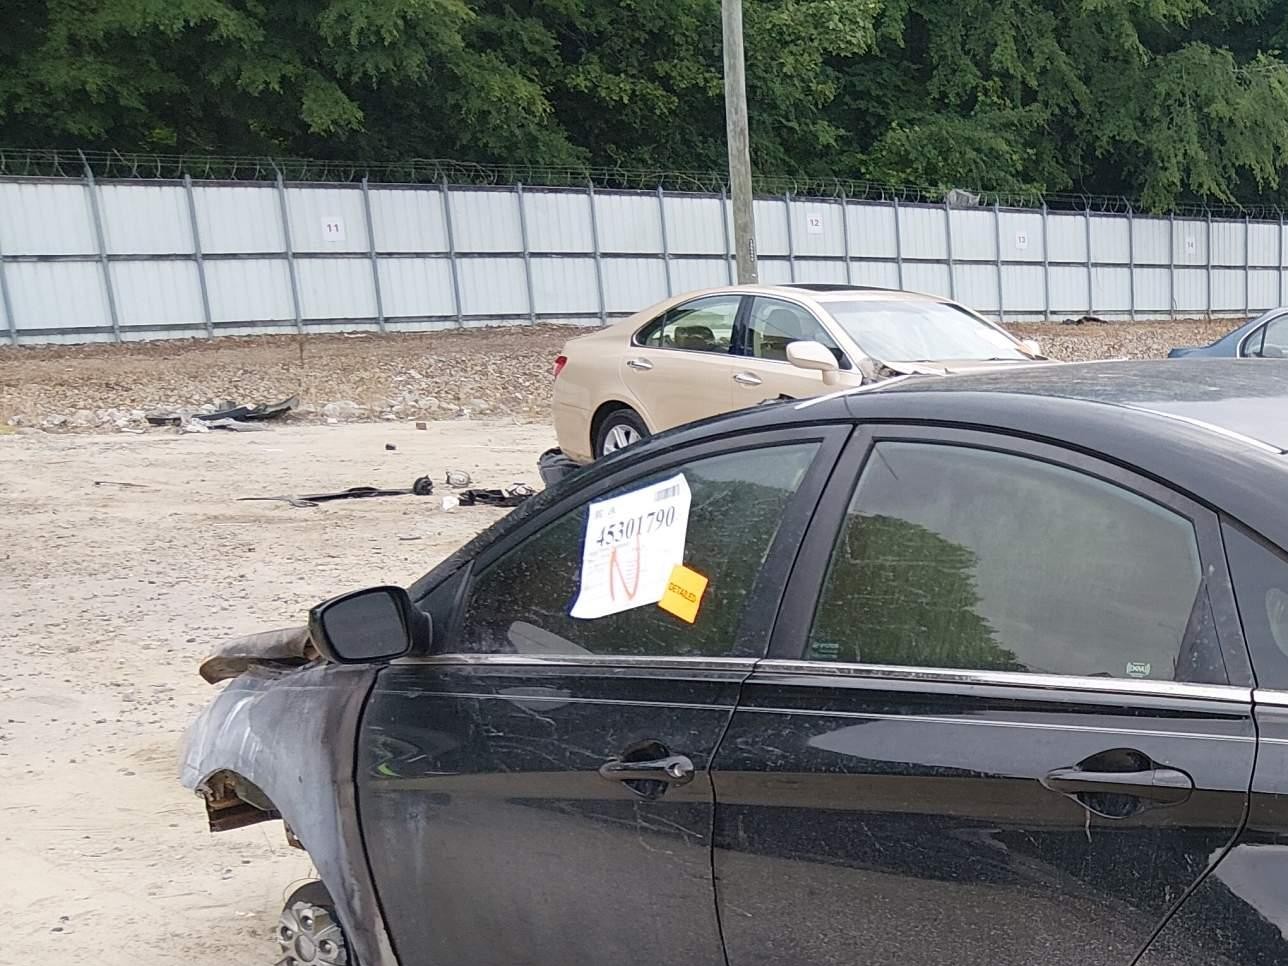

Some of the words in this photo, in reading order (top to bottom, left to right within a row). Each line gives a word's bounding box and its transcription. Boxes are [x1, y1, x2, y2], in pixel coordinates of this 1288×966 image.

[809, 218, 821, 227] 12
[326, 223, 340, 233] 11
[596, 505, 676, 547] 45301790
